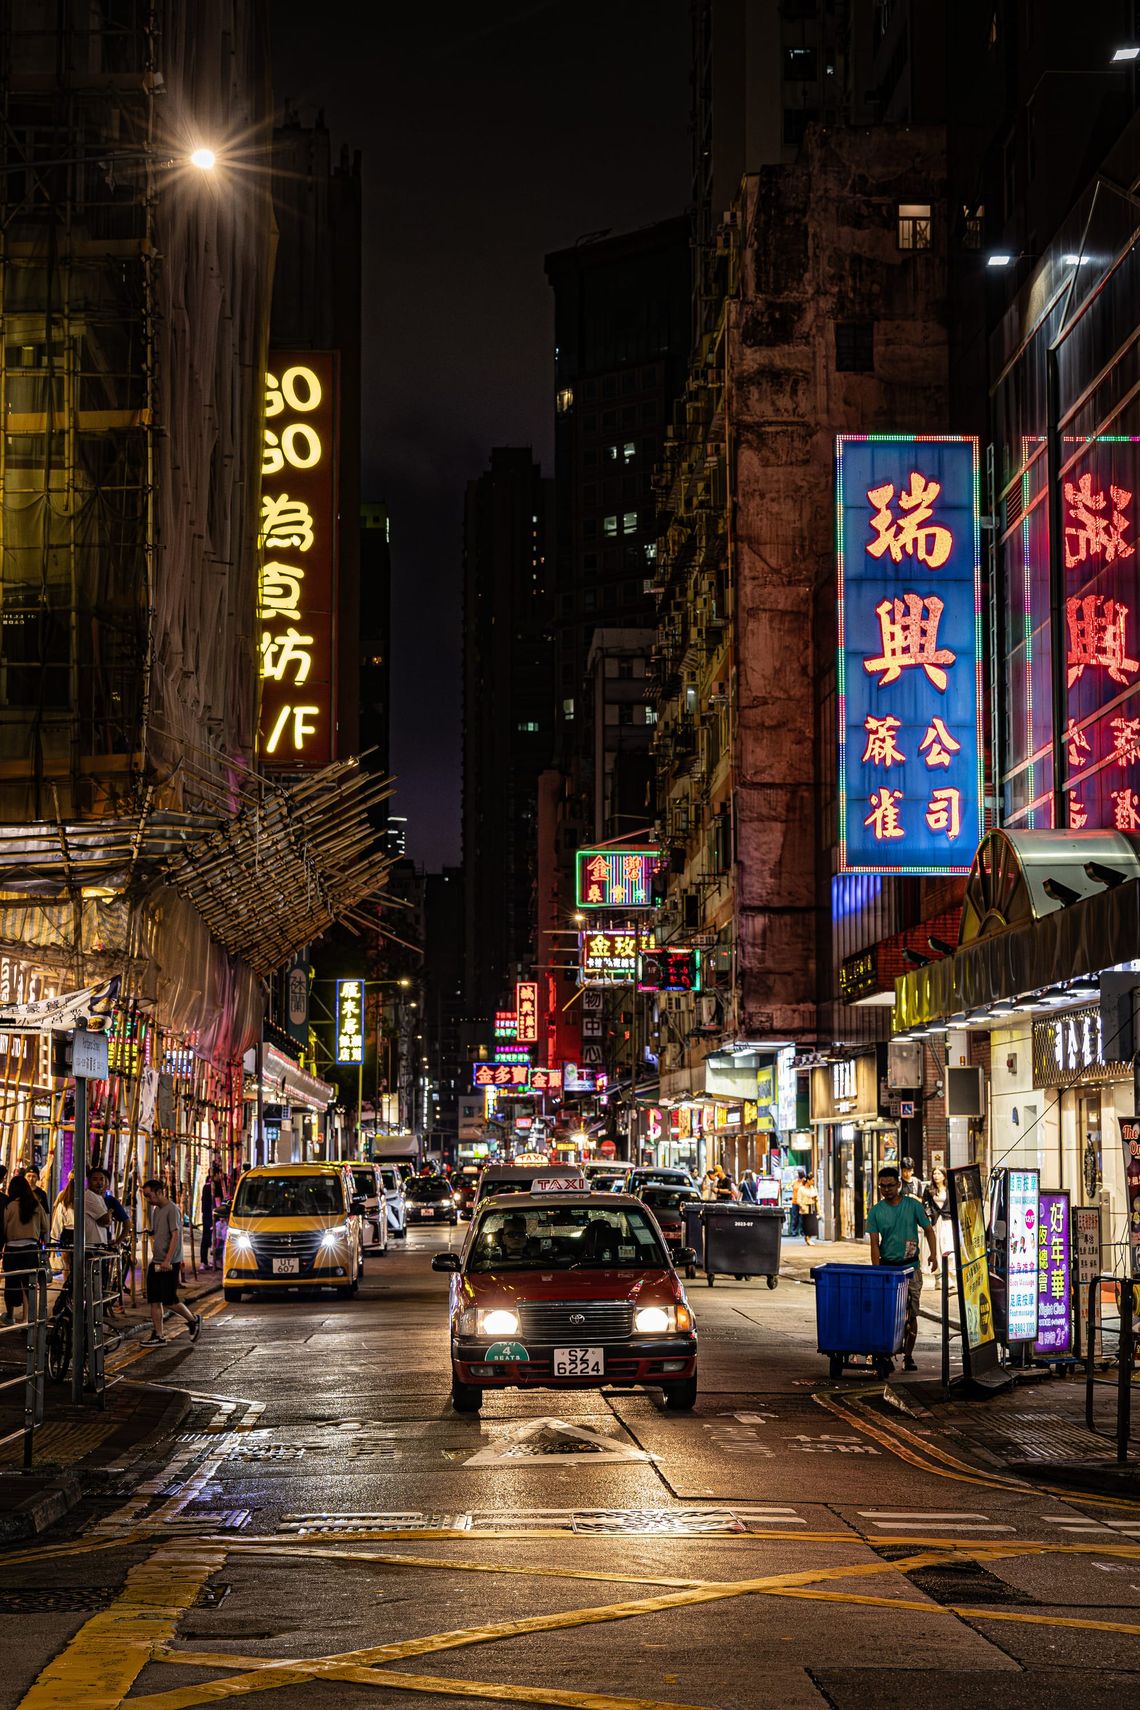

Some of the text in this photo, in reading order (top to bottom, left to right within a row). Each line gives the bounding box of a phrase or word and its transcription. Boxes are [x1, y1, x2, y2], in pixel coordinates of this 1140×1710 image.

[863, 471, 956, 693] 瑞興
[919, 716, 961, 841] 公司
[476, 1065, 528, 1084] 金多寶
[1122, 1124, 1138, 1140] The
[537, 1179, 584, 1190] TAXI
[1050, 1202, 1065, 1300] 好年華
[280, 1258, 292, 1266] UT
[502, 1347, 511, 1355] 4
[568, 1349, 590, 1362] SZ
[557, 1362, 601, 1375] 6224
